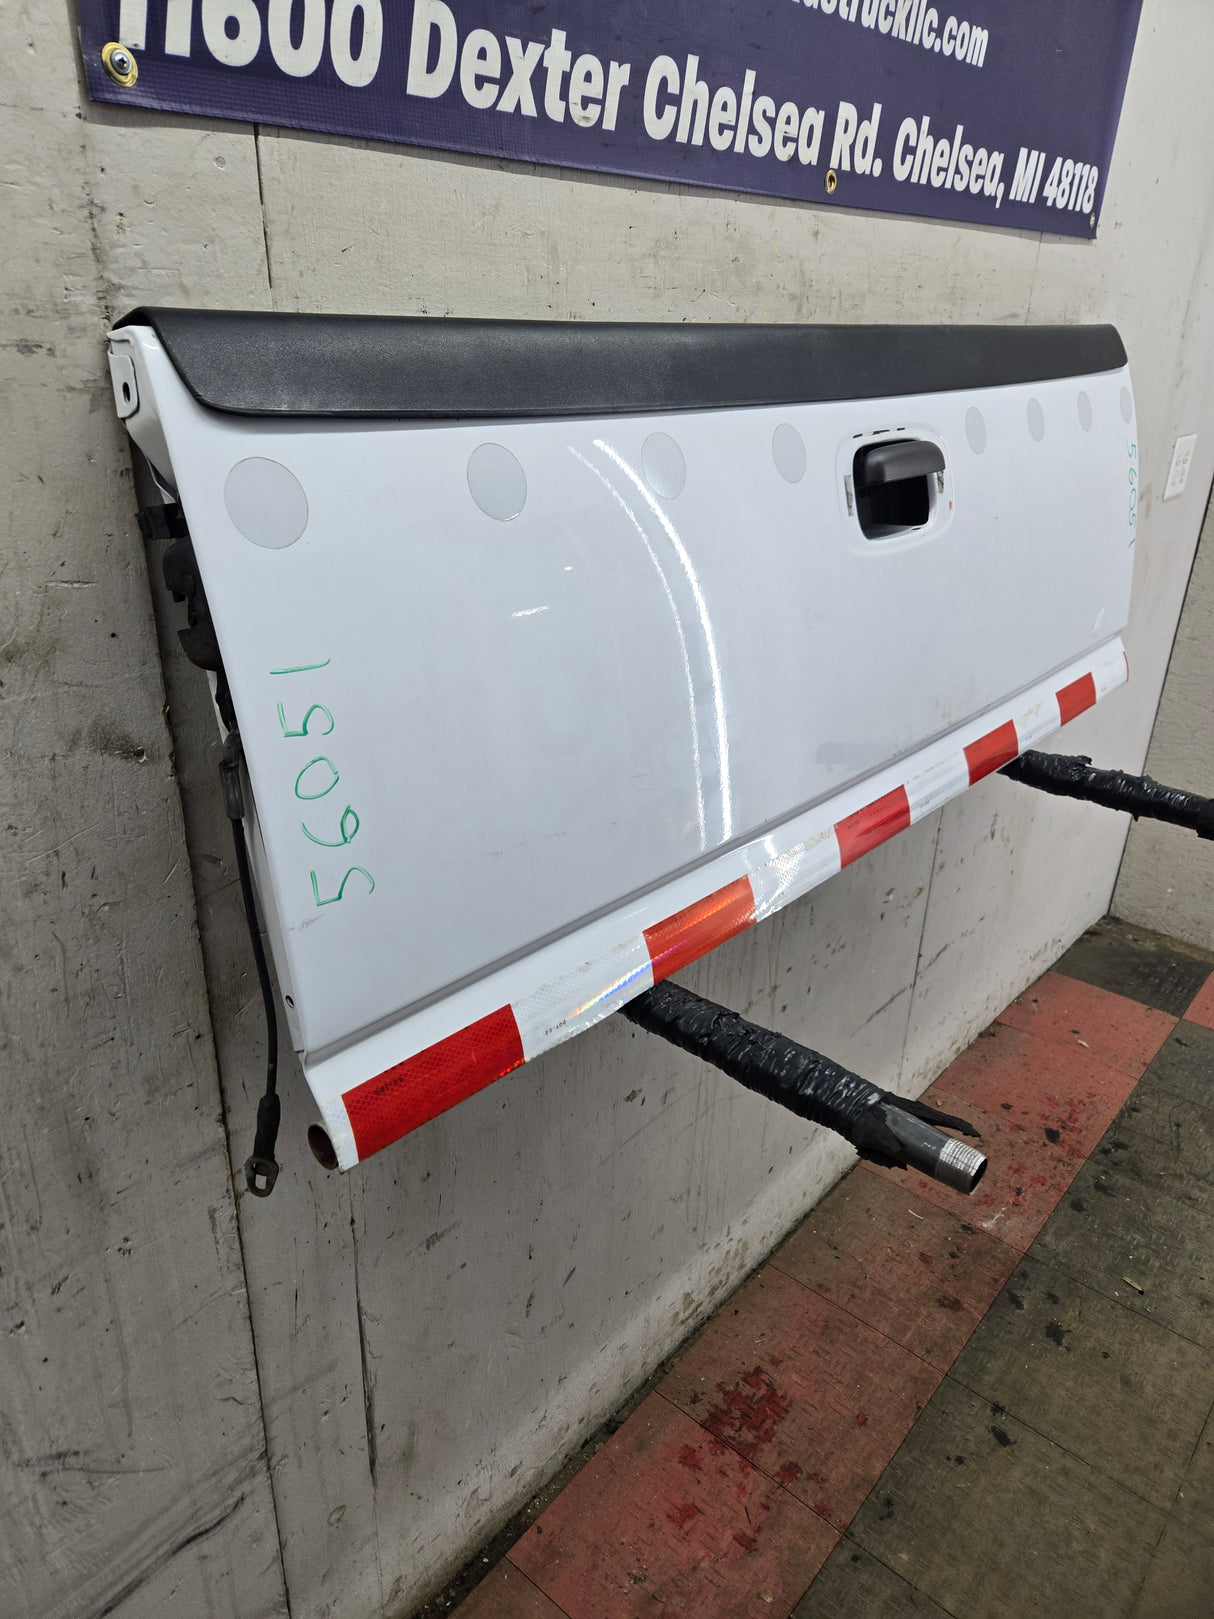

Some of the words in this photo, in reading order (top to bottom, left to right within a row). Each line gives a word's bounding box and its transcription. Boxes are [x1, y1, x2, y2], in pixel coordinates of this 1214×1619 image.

[406, 0, 631, 131] Dexter
[643, 53, 825, 166] Chelsea
[829, 100, 883, 178] Rd.
[892, 116, 1005, 208] Chelsea,
[1008, 147, 1047, 203] MI
[1042, 156, 1099, 214] 48118
[269, 658, 375, 907] 56051
